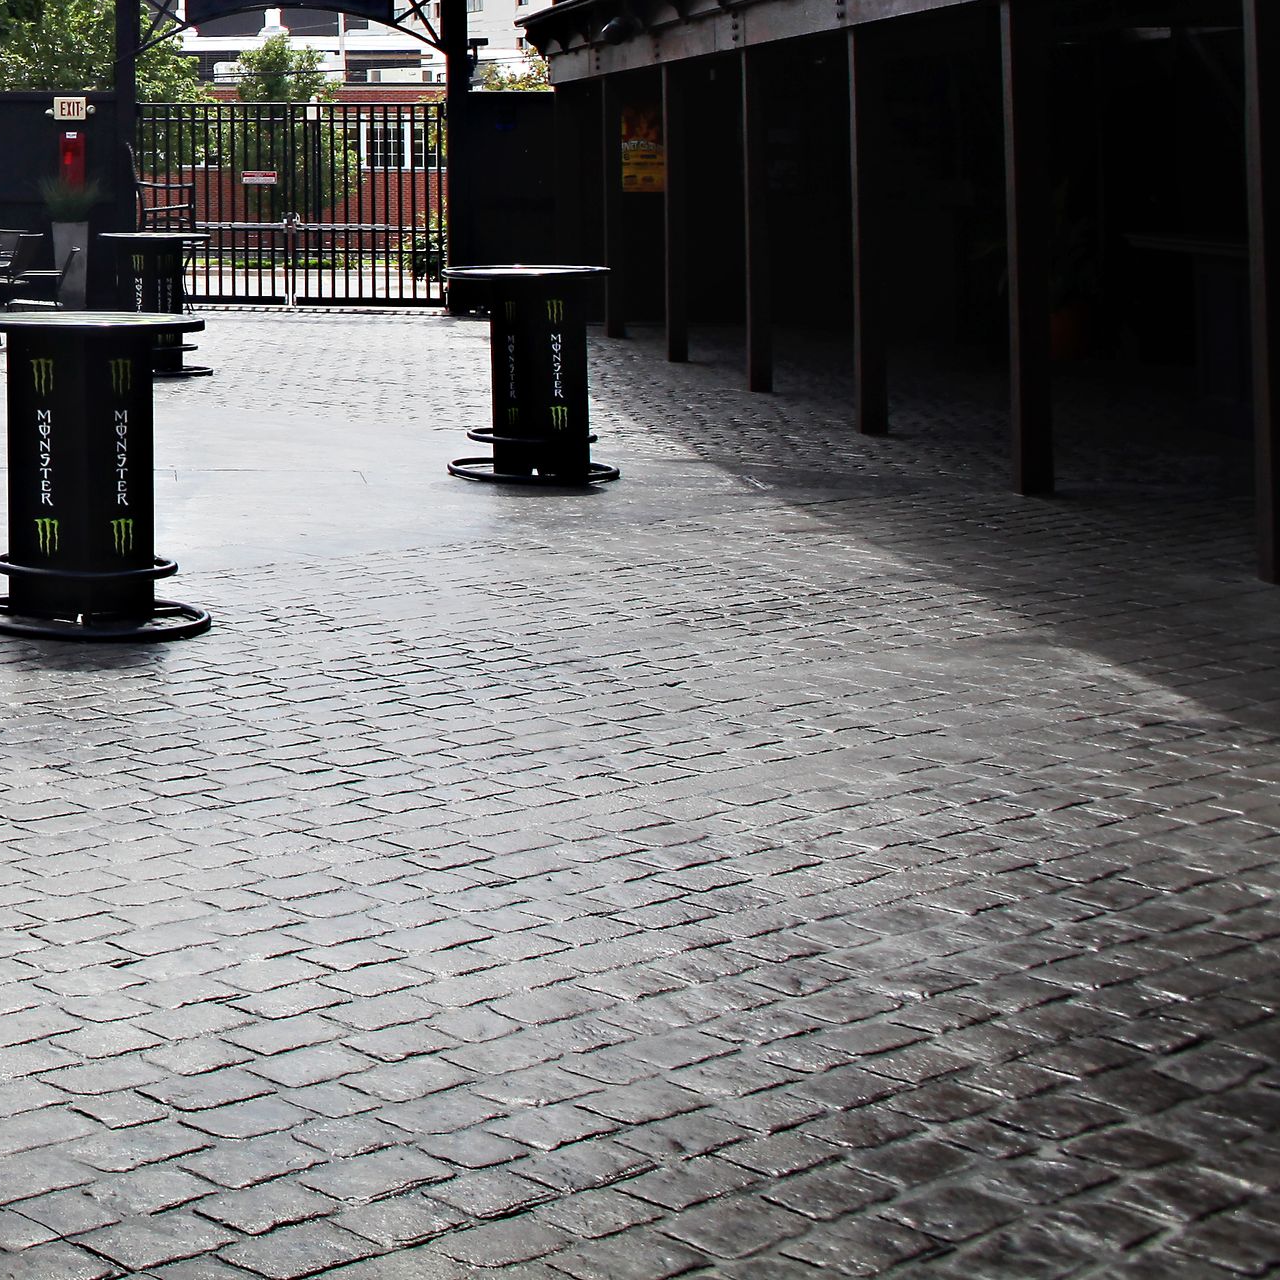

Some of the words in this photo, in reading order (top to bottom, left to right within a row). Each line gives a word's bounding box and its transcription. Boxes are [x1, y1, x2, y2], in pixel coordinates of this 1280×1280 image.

[60, 101, 81, 116] EXIT
[550, 333, 564, 399] MONSTER
[37, 409, 54, 506] MONSTER
[114, 409, 129, 506] MONSTER
